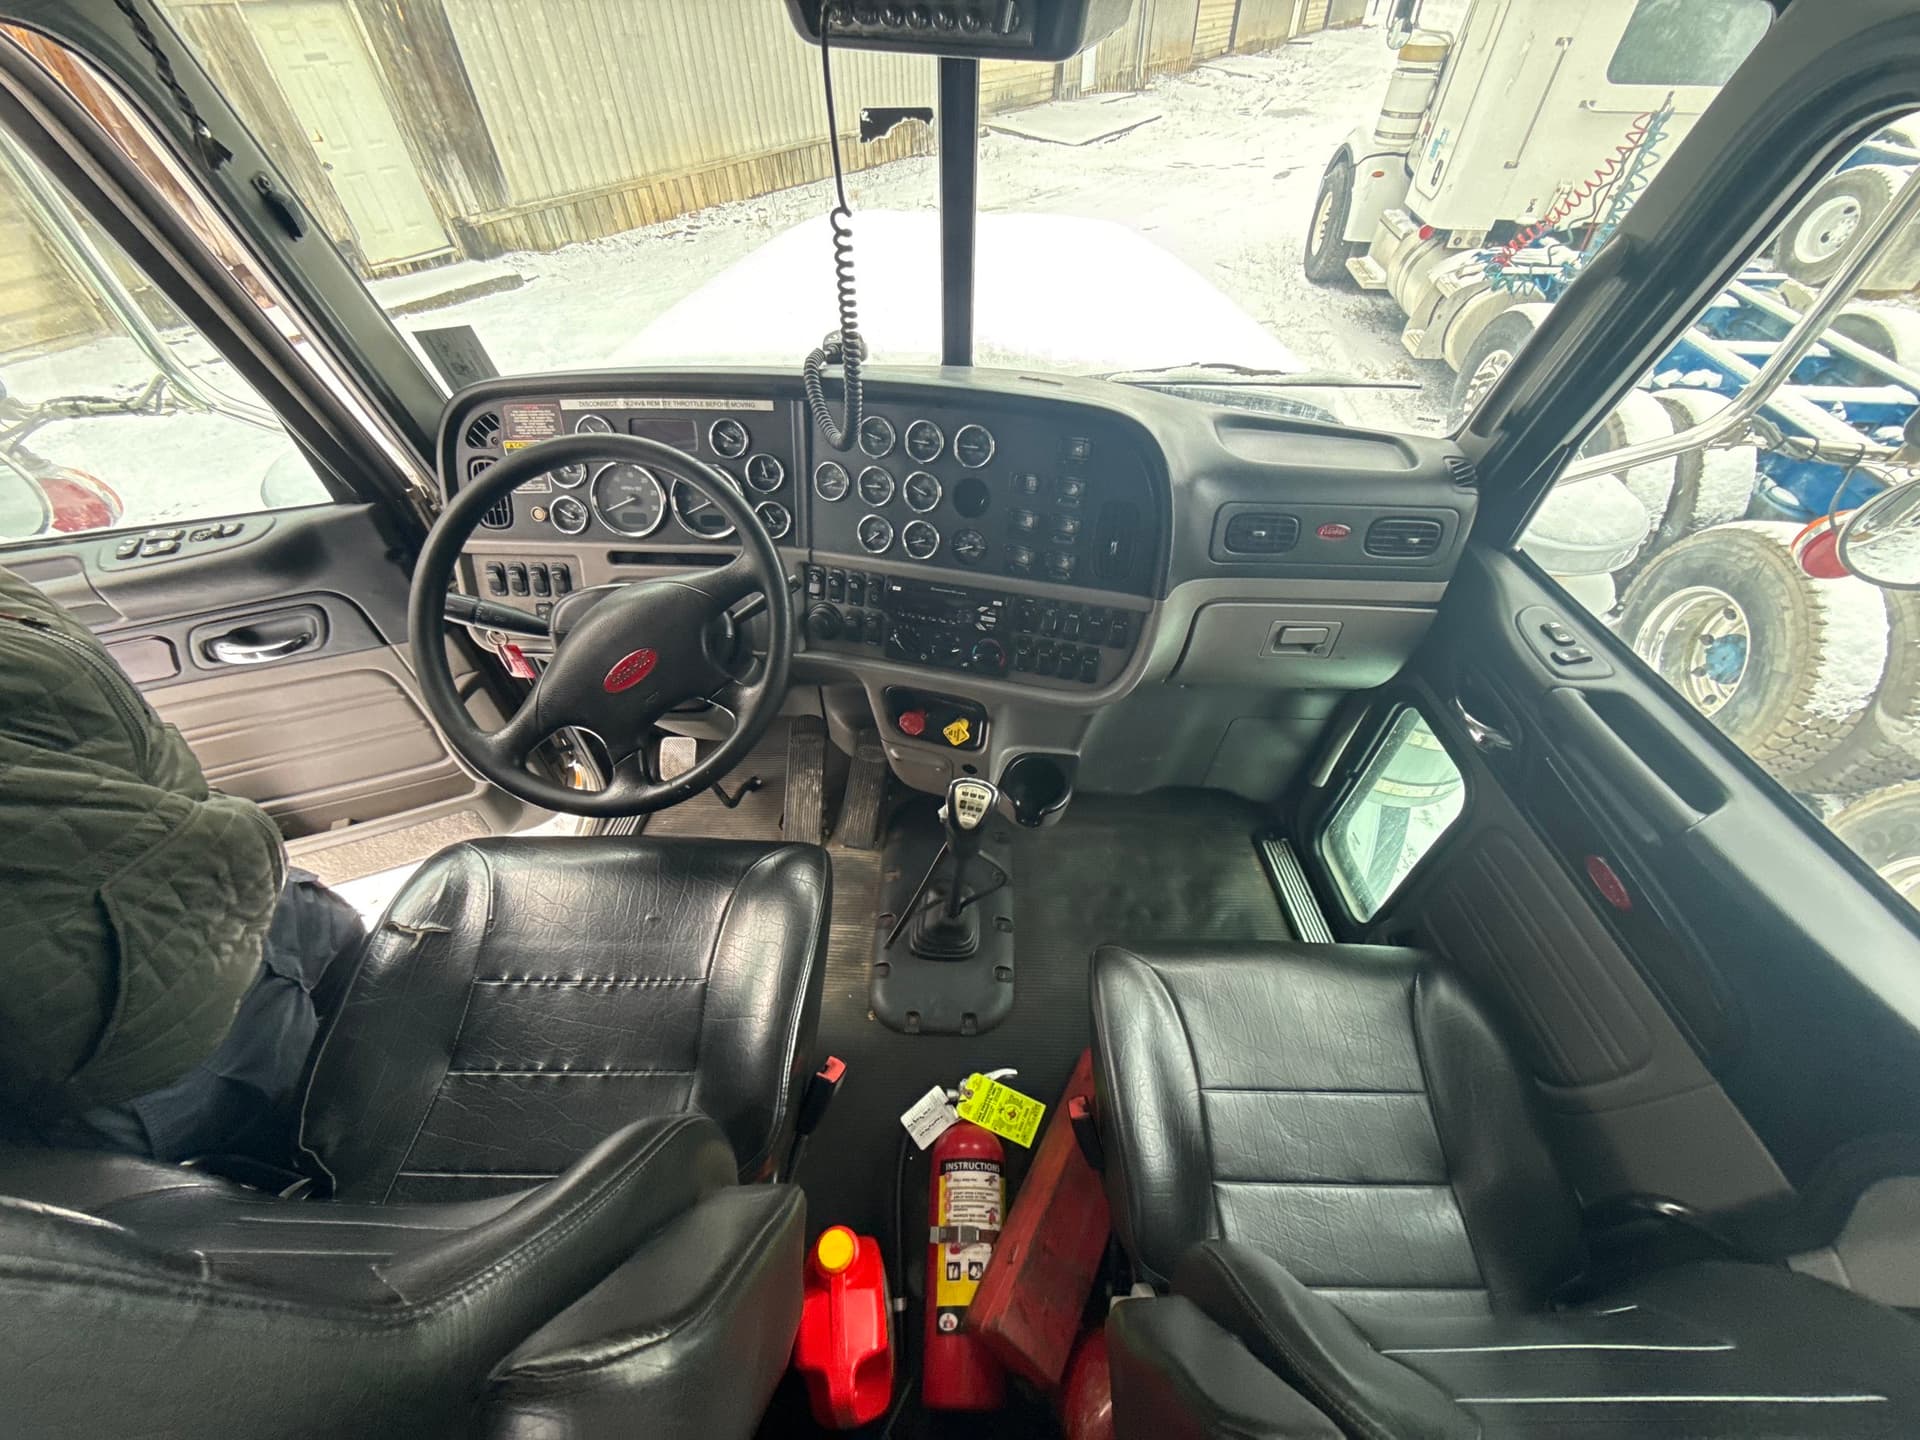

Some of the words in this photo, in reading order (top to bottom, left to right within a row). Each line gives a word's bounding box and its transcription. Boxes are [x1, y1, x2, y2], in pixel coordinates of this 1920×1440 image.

[646, 400, 671, 408] REMTE
[673, 400, 704, 408] THROTTLE
[731, 401, 756, 409] MOVING
[945, 1161, 1000, 1173] INSTRUCTIONS
